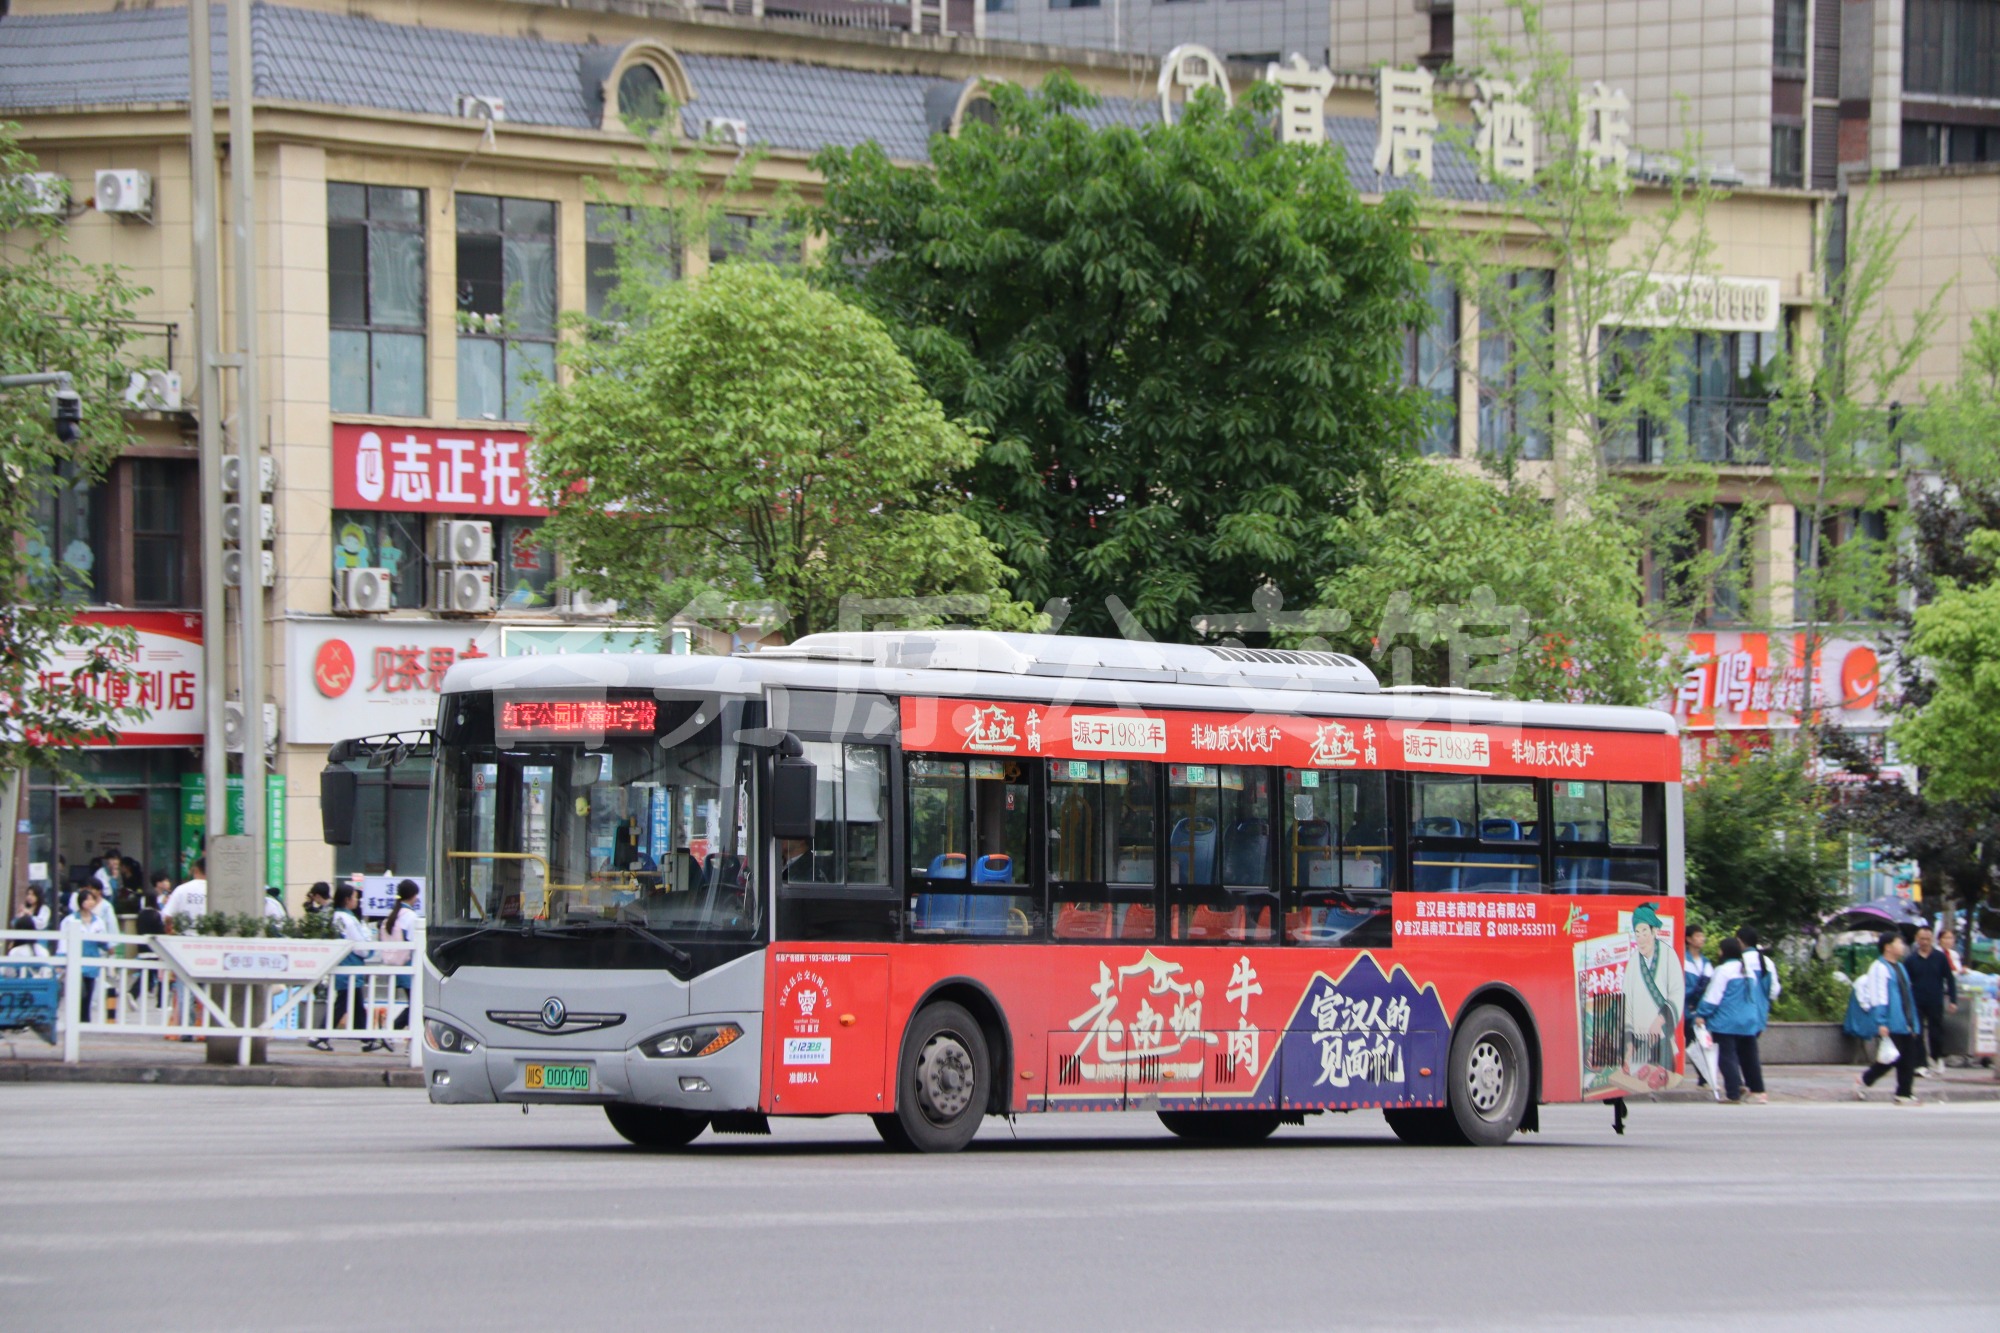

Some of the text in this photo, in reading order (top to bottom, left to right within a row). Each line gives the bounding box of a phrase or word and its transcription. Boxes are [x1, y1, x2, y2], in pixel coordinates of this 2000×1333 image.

[391, 435, 561, 507] 志正托
[367, 638, 488, 693] 见茶思
[1026, 708, 1041, 753] 牛肉
[1073, 716, 1165, 749] 源于1983年
[1191, 724, 1282, 752] 非物质文化遗产
[1363, 724, 1377, 765] 牛肉
[1405, 734, 1488, 762] 源于1983年
[1512, 739, 1594, 767] 非物质文化遗产
[1403, 921, 1482, 936] 宣汉县南坝工业园区
[1497, 922, 1556, 936] 0818-5535111
[1416, 901, 1536, 919] 宣汉县老南坝食品有限公司
[1226, 955, 1263, 1077] 牛肉
[1311, 985, 1411, 1043] 宣汉人的
[1313, 1033, 1405, 1088] 见面礼
